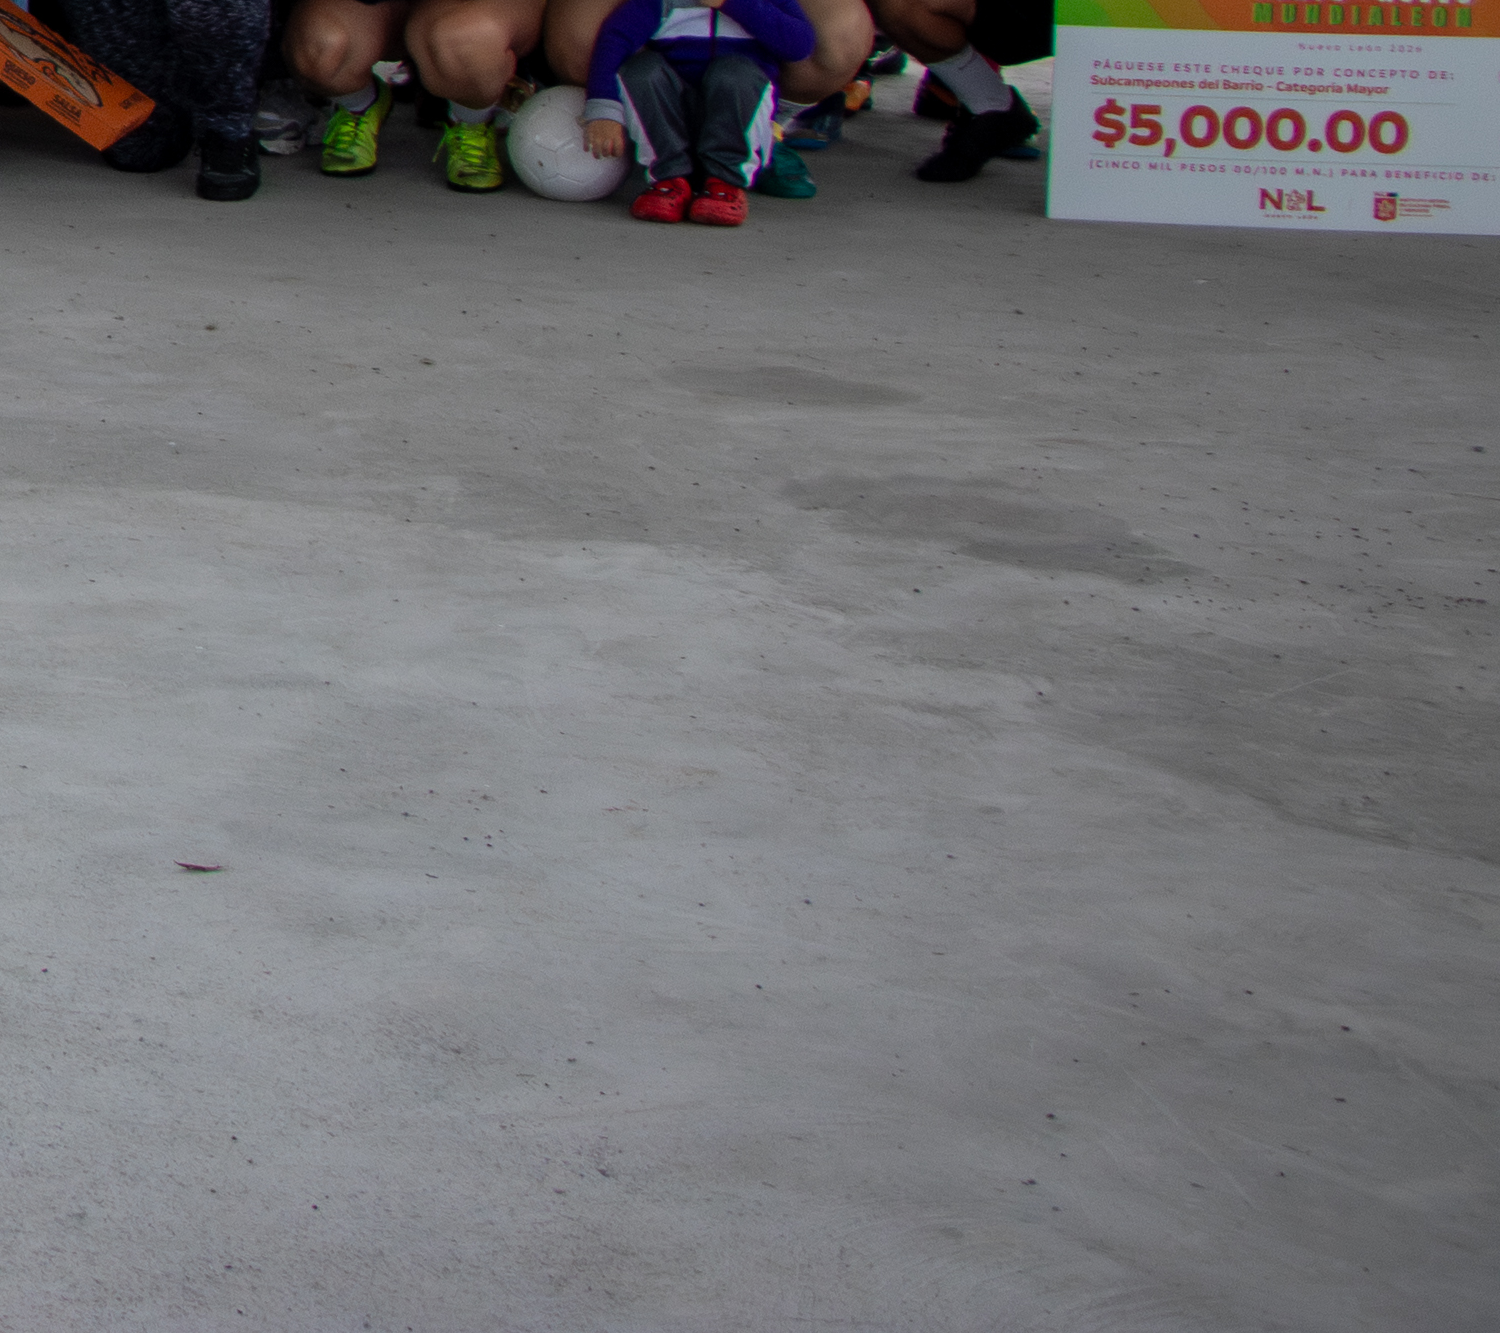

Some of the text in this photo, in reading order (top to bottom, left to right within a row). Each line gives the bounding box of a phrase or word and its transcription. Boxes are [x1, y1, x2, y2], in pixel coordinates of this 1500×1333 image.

[1090, 74, 1195, 89] Subcampeones
[1198, 78, 1220, 90] del
[1223, 79, 1264, 91] Barrio
[1346, 83, 1390, 96] Mayor
[1092, 97, 1410, 158] $5,000.00
